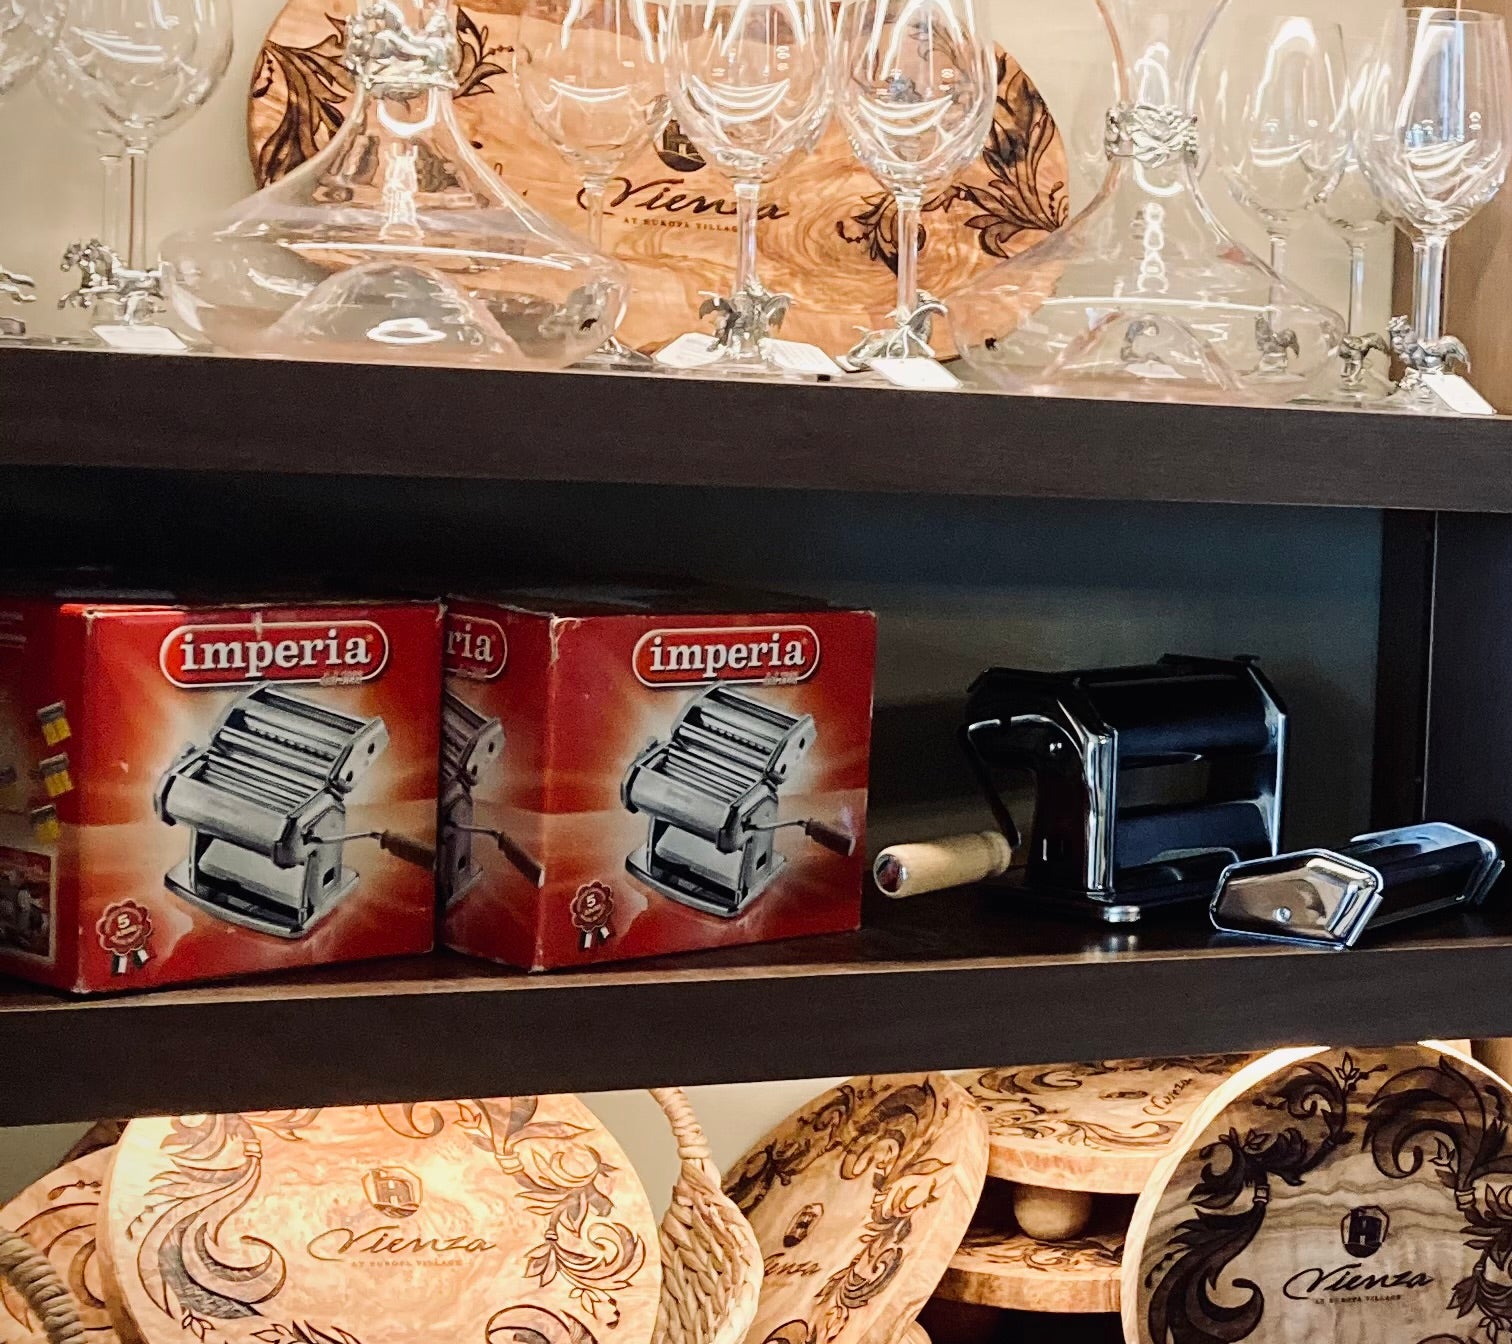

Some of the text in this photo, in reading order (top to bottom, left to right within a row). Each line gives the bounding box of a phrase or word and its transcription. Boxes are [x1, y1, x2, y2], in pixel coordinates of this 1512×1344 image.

[576, 176, 790, 220] Viena
[180, 628, 372, 678] imperia
[649, 632, 806, 677] imperia
[306, 1225, 497, 1262] Vienza
[1283, 1263, 1434, 1301] Vienza
